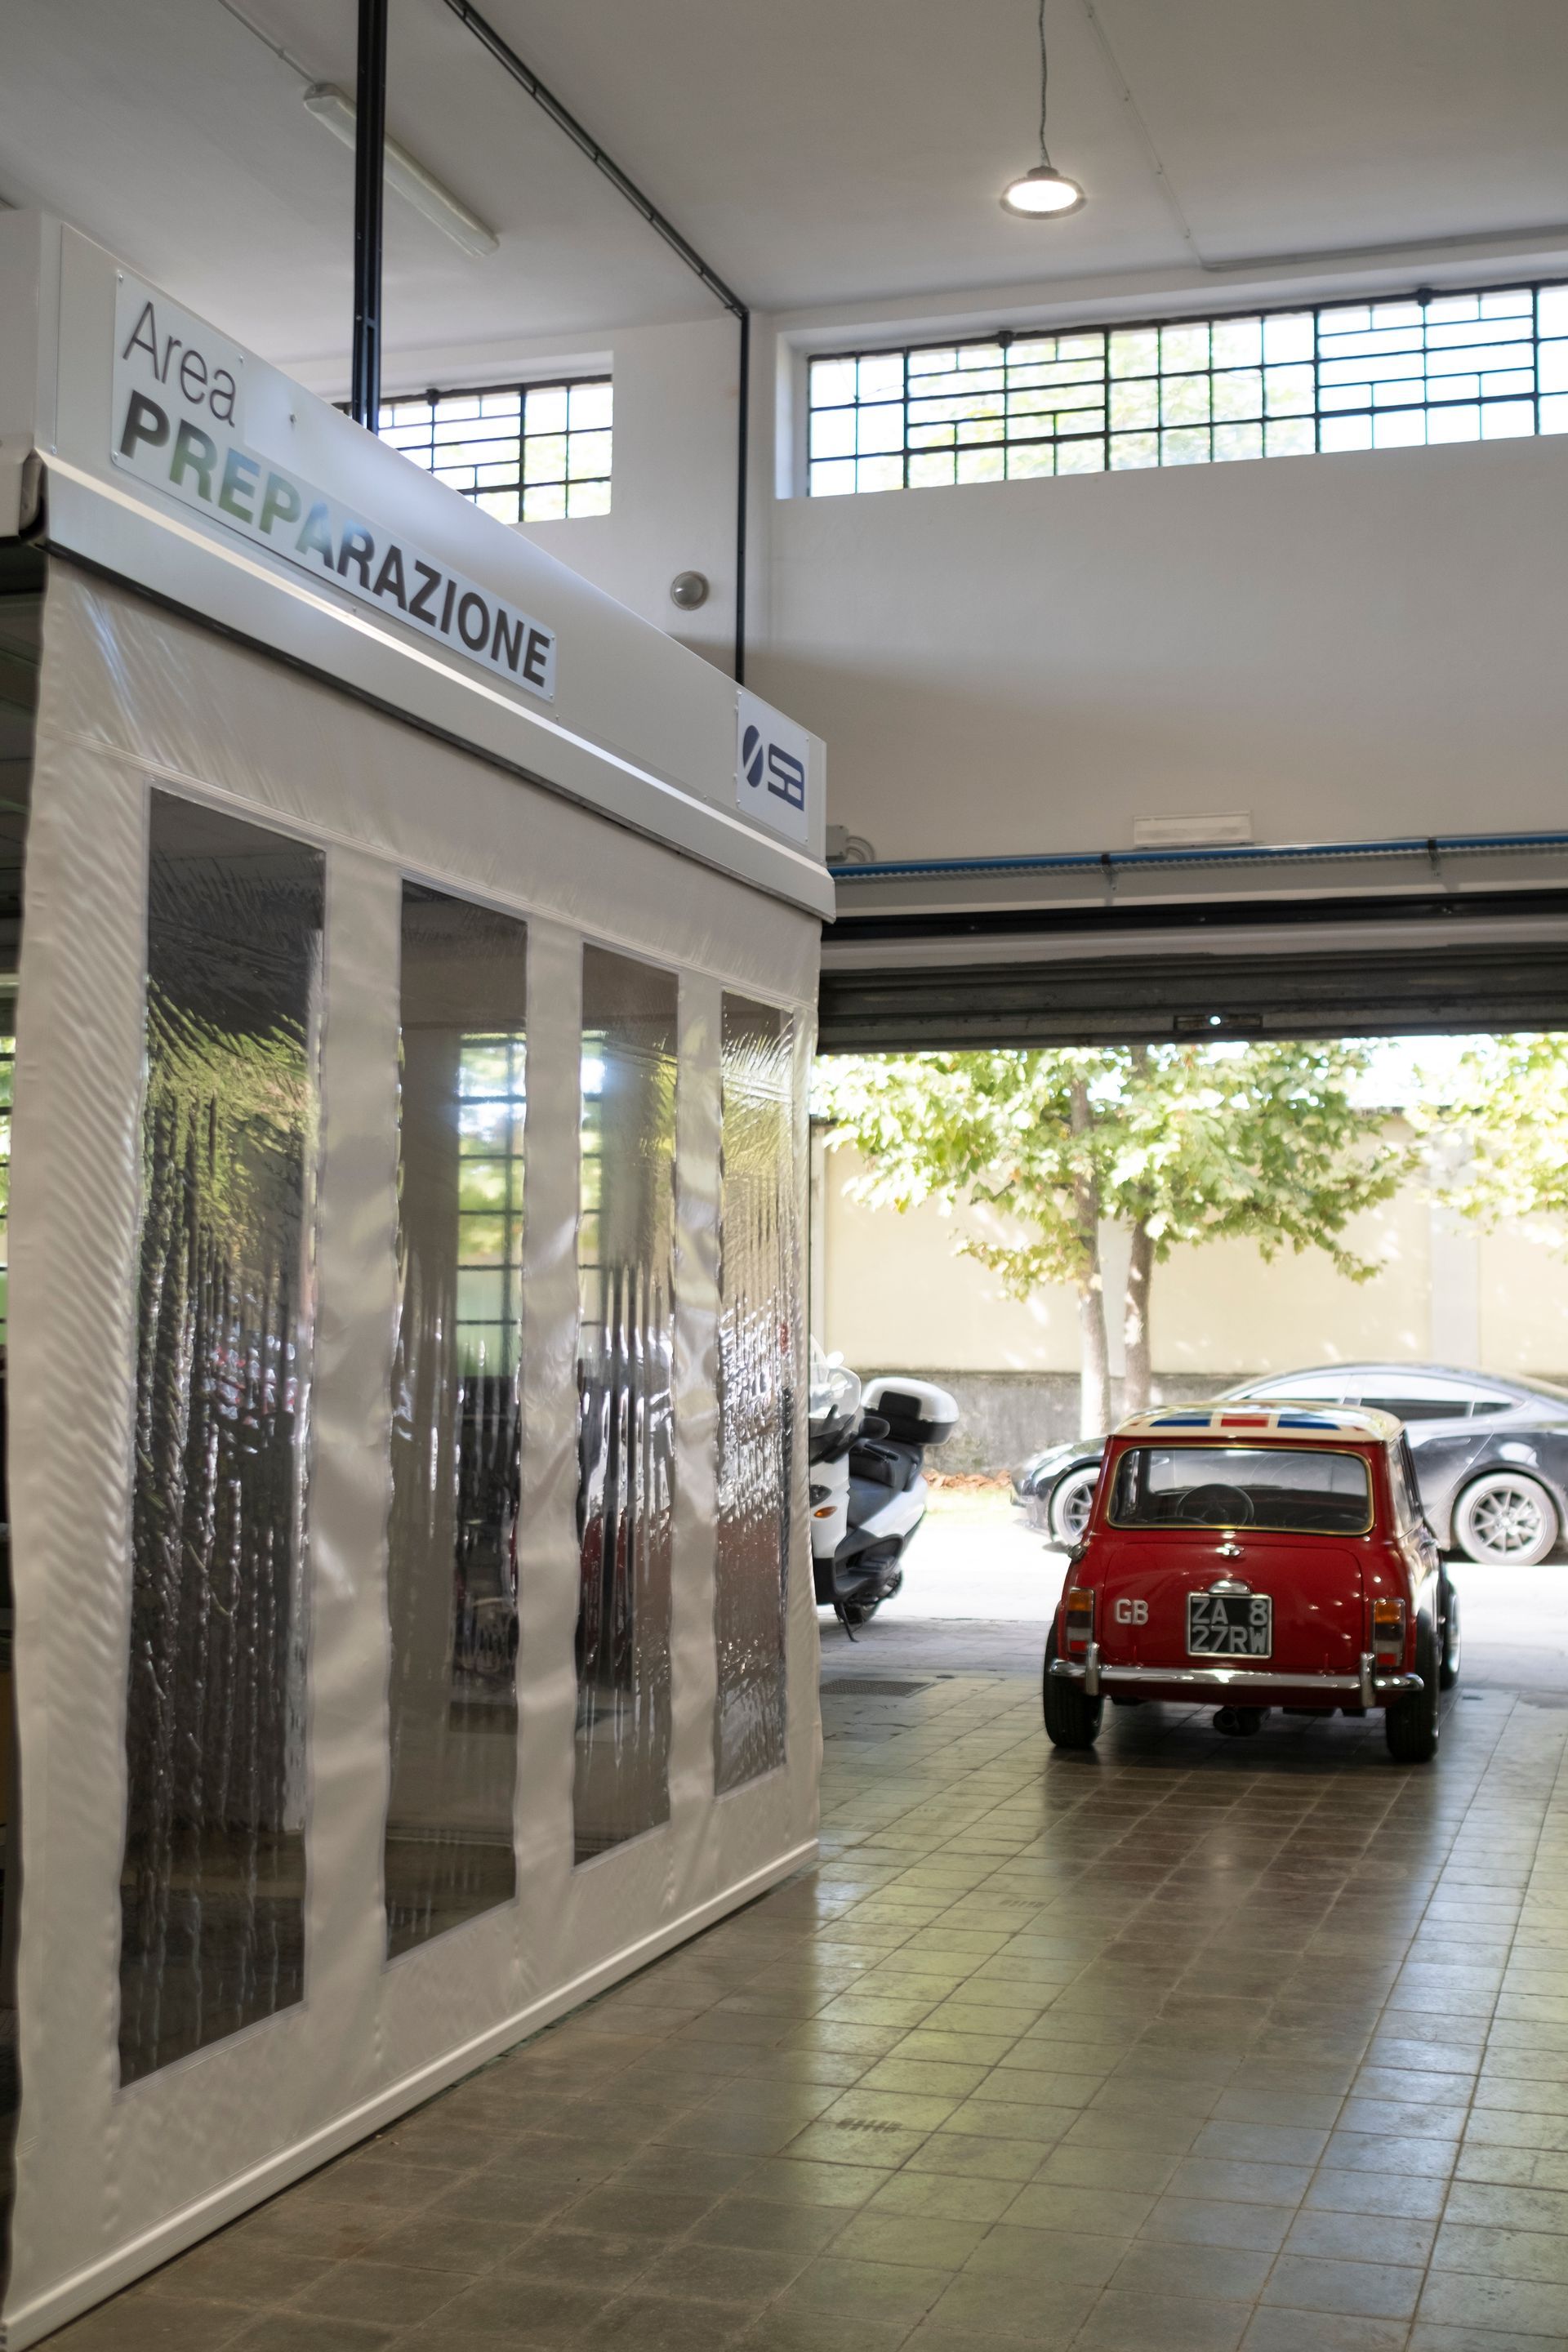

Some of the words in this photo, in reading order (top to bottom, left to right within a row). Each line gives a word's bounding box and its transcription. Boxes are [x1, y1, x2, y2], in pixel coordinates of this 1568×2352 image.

[122, 300, 236, 428] Area
[119, 389, 552, 688] PREPARAZIONE
[1115, 1598, 1149, 1625] GB
[1192, 1598, 1229, 1625] ZA
[1250, 1599, 1268, 1626] 8
[1191, 1625, 1267, 1654] 27RW
